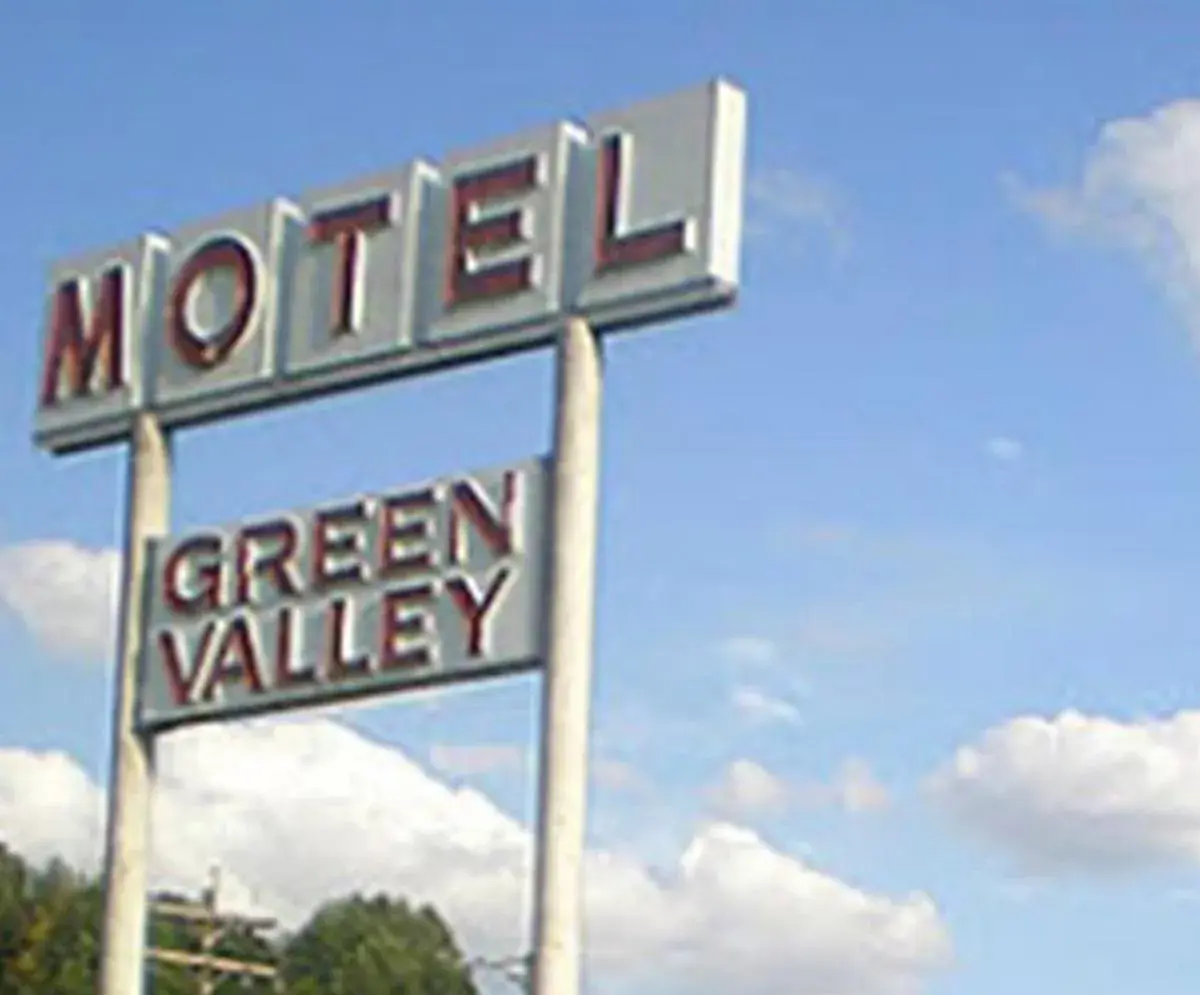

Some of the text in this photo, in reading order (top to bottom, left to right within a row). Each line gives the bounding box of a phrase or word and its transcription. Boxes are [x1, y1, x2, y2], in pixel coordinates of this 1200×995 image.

[40, 130, 697, 407] MOTEL
[160, 468, 523, 618] GREEN
[156, 566, 518, 704] VALLEY
